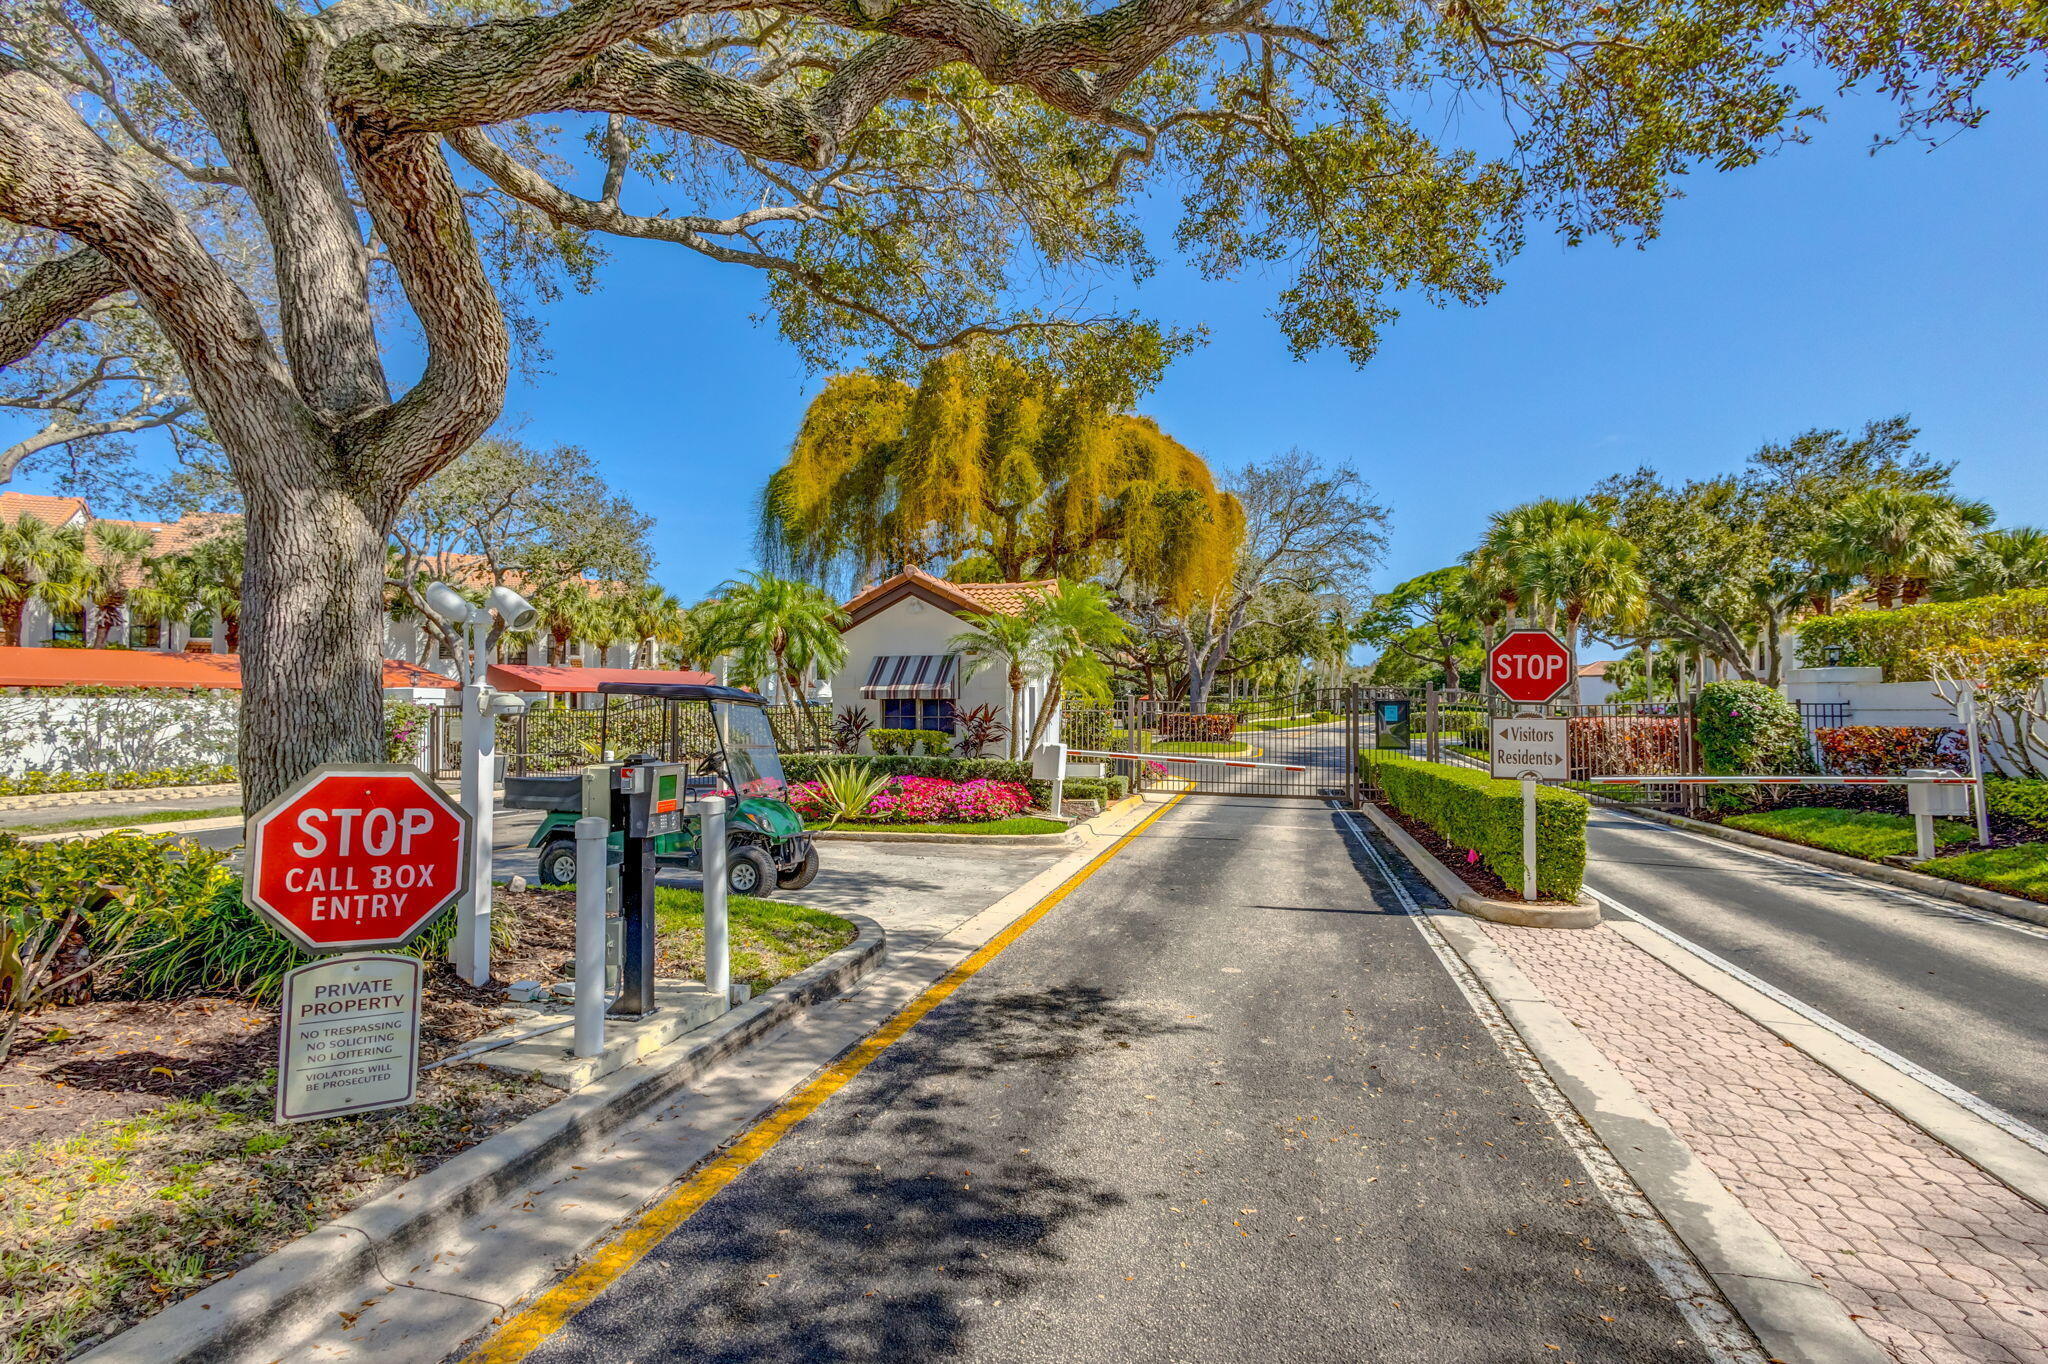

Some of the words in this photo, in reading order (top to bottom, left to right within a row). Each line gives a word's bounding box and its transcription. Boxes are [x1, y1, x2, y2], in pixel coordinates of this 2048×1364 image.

[1496, 654, 1564, 680] STOP
[1511, 726, 1554, 742] Visitors
[1498, 749, 1553, 766] Residents
[292, 807, 435, 859] STOP
[285, 866, 359, 893] CALL
[371, 864, 435, 889] BOX
[311, 893, 408, 921] ENTRY
[314, 978, 393, 999] PRIVATE
[300, 994, 404, 1018] PROPERTY
[300, 1030, 319, 1040] NO
[323, 1020, 402, 1037] TRESPASSING
[306, 1042, 326, 1052] NO
[329, 1033, 395, 1049] SOLICITING
[307, 1054, 326, 1064] NO
[330, 1045, 393, 1061] LOITERING
[305, 1067, 365, 1082] VIOLATORS
[368, 1063, 392, 1073] WILL
[305, 1084, 319, 1092] BE
[322, 1073, 391, 1090] PROSECUTED
